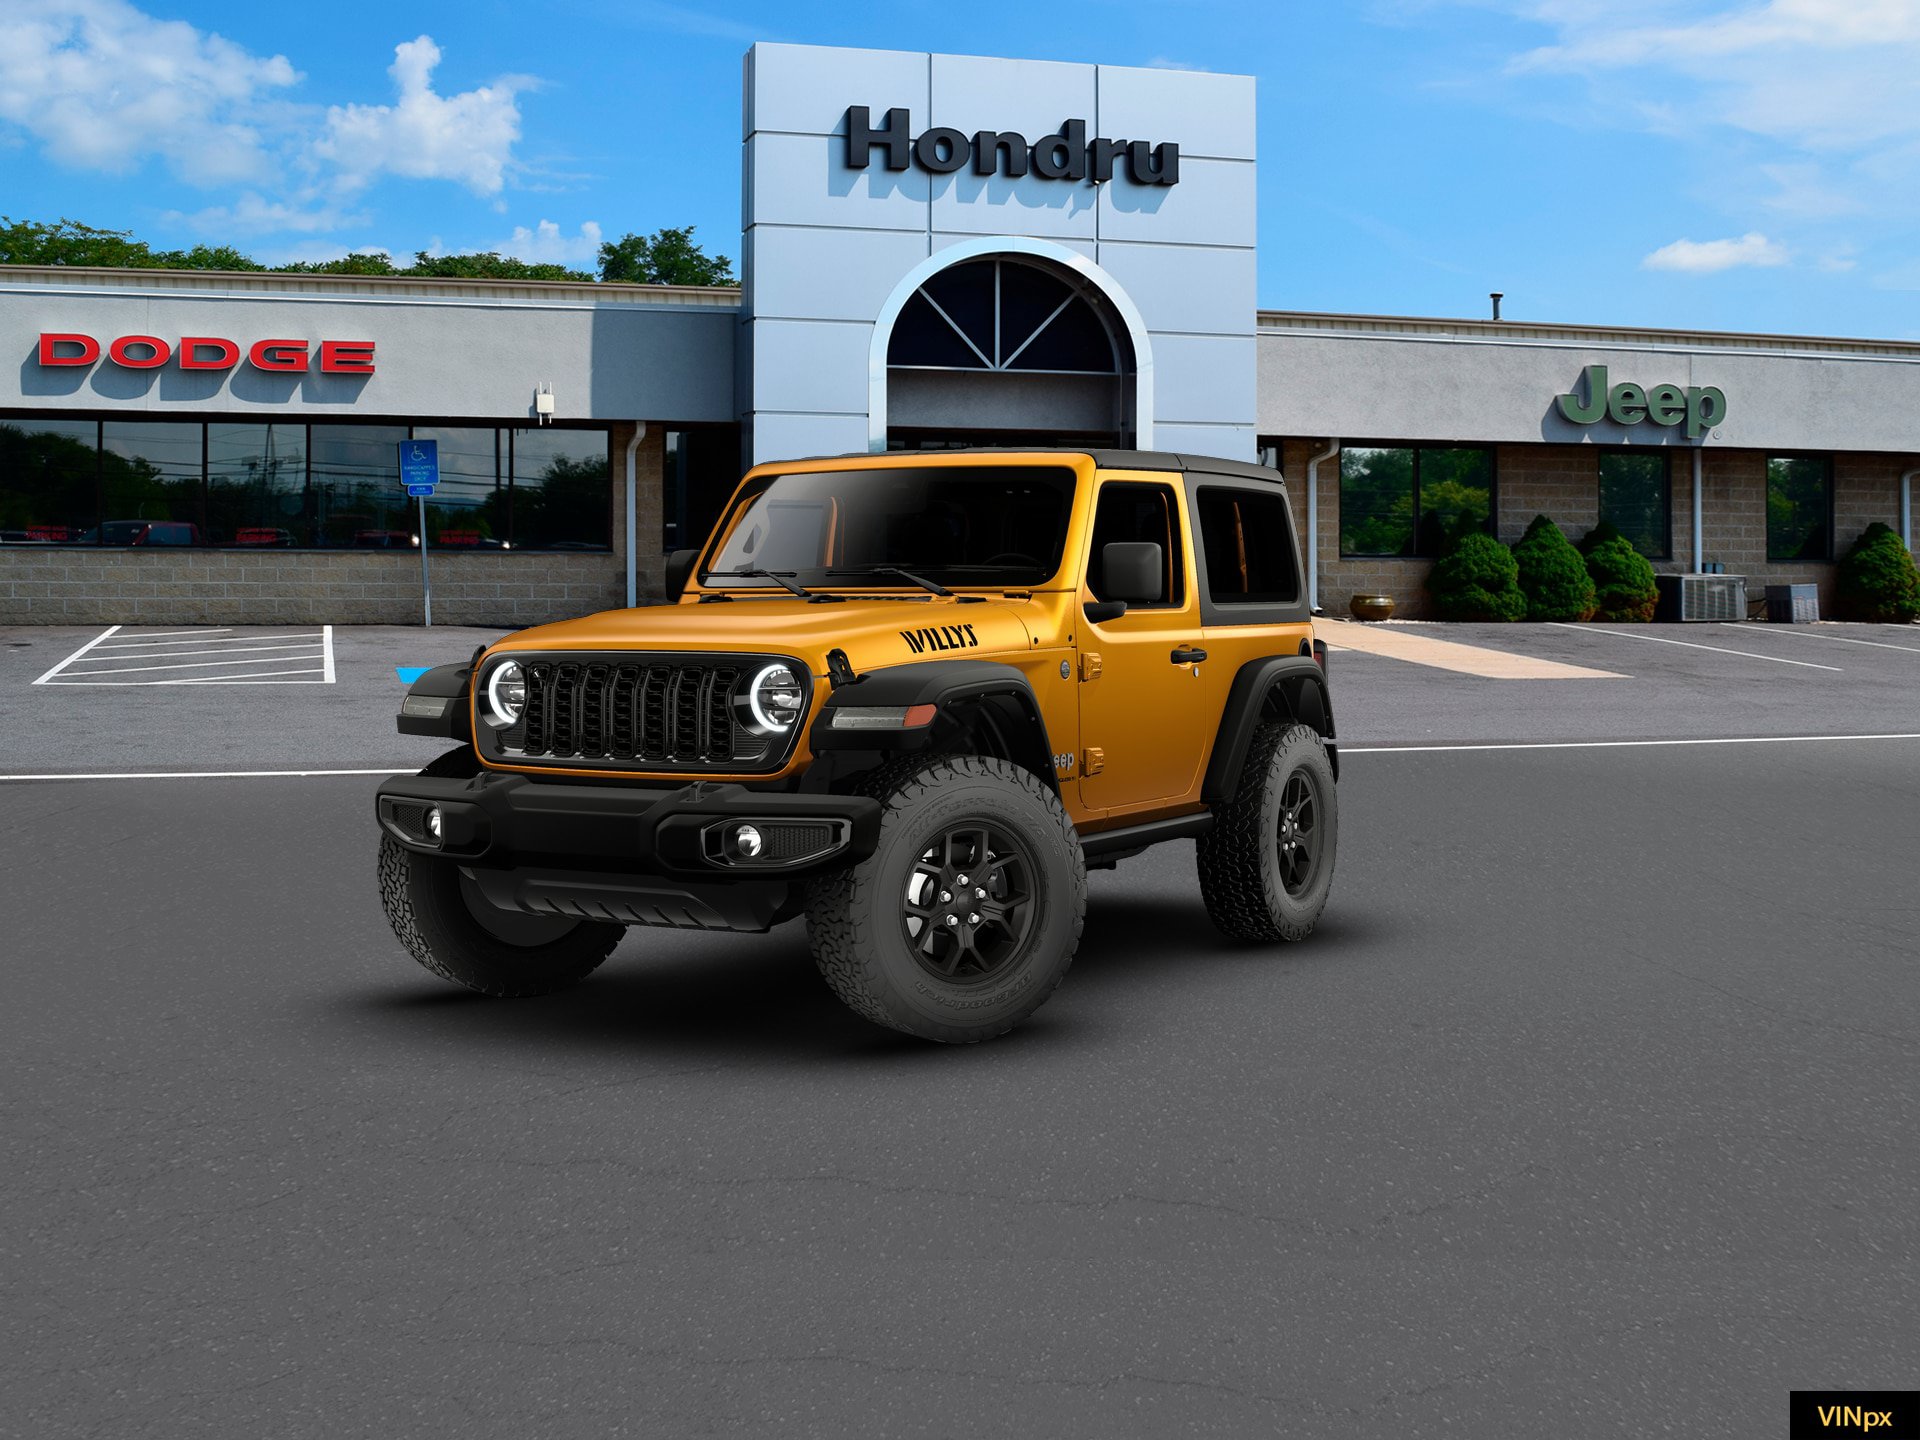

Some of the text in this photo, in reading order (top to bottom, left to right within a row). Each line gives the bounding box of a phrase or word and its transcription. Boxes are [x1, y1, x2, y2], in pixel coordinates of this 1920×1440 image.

[846, 105, 1180, 187] Hondru
[39, 332, 376, 374] DODGE
[1556, 365, 1727, 439] Jeep
[899, 624, 978, 653] WILLYS
[1053, 752, 1074, 771] eep
